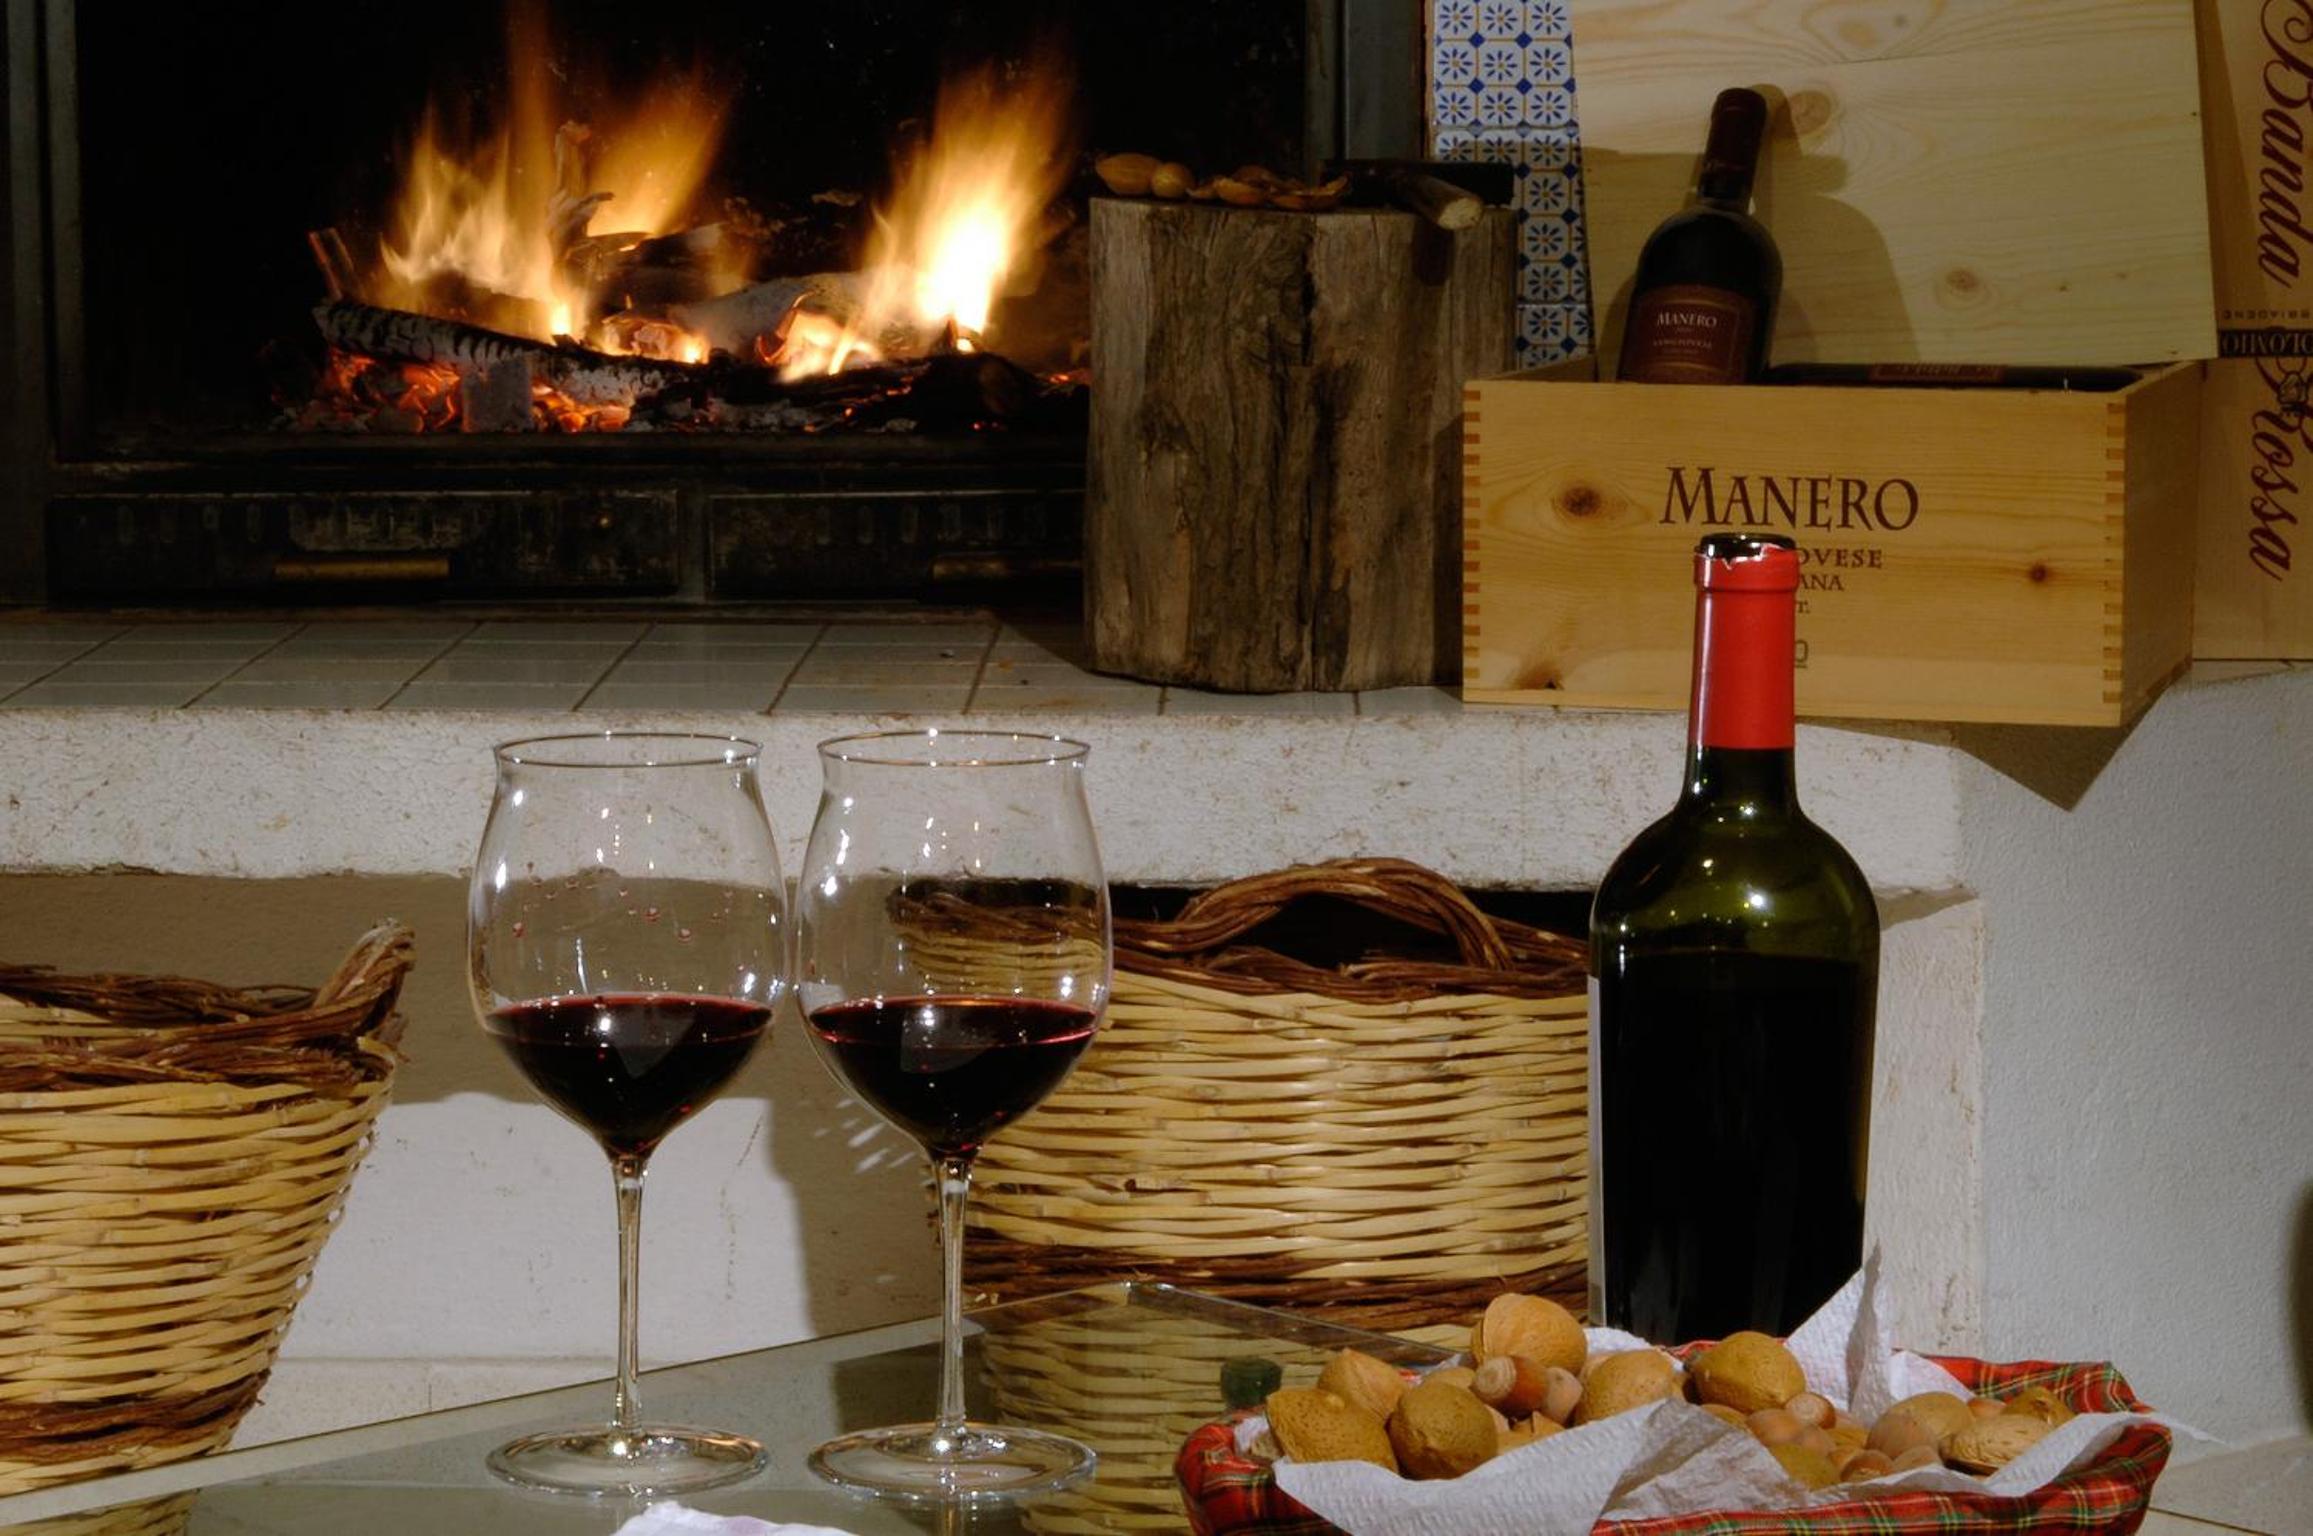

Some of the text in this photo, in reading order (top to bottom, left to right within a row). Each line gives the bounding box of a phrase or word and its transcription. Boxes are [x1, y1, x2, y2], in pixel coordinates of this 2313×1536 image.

[1657, 311, 1718, 328] MANERO
[1658, 466, 1920, 531] MANERO
[1797, 547, 1883, 569] OVESE
